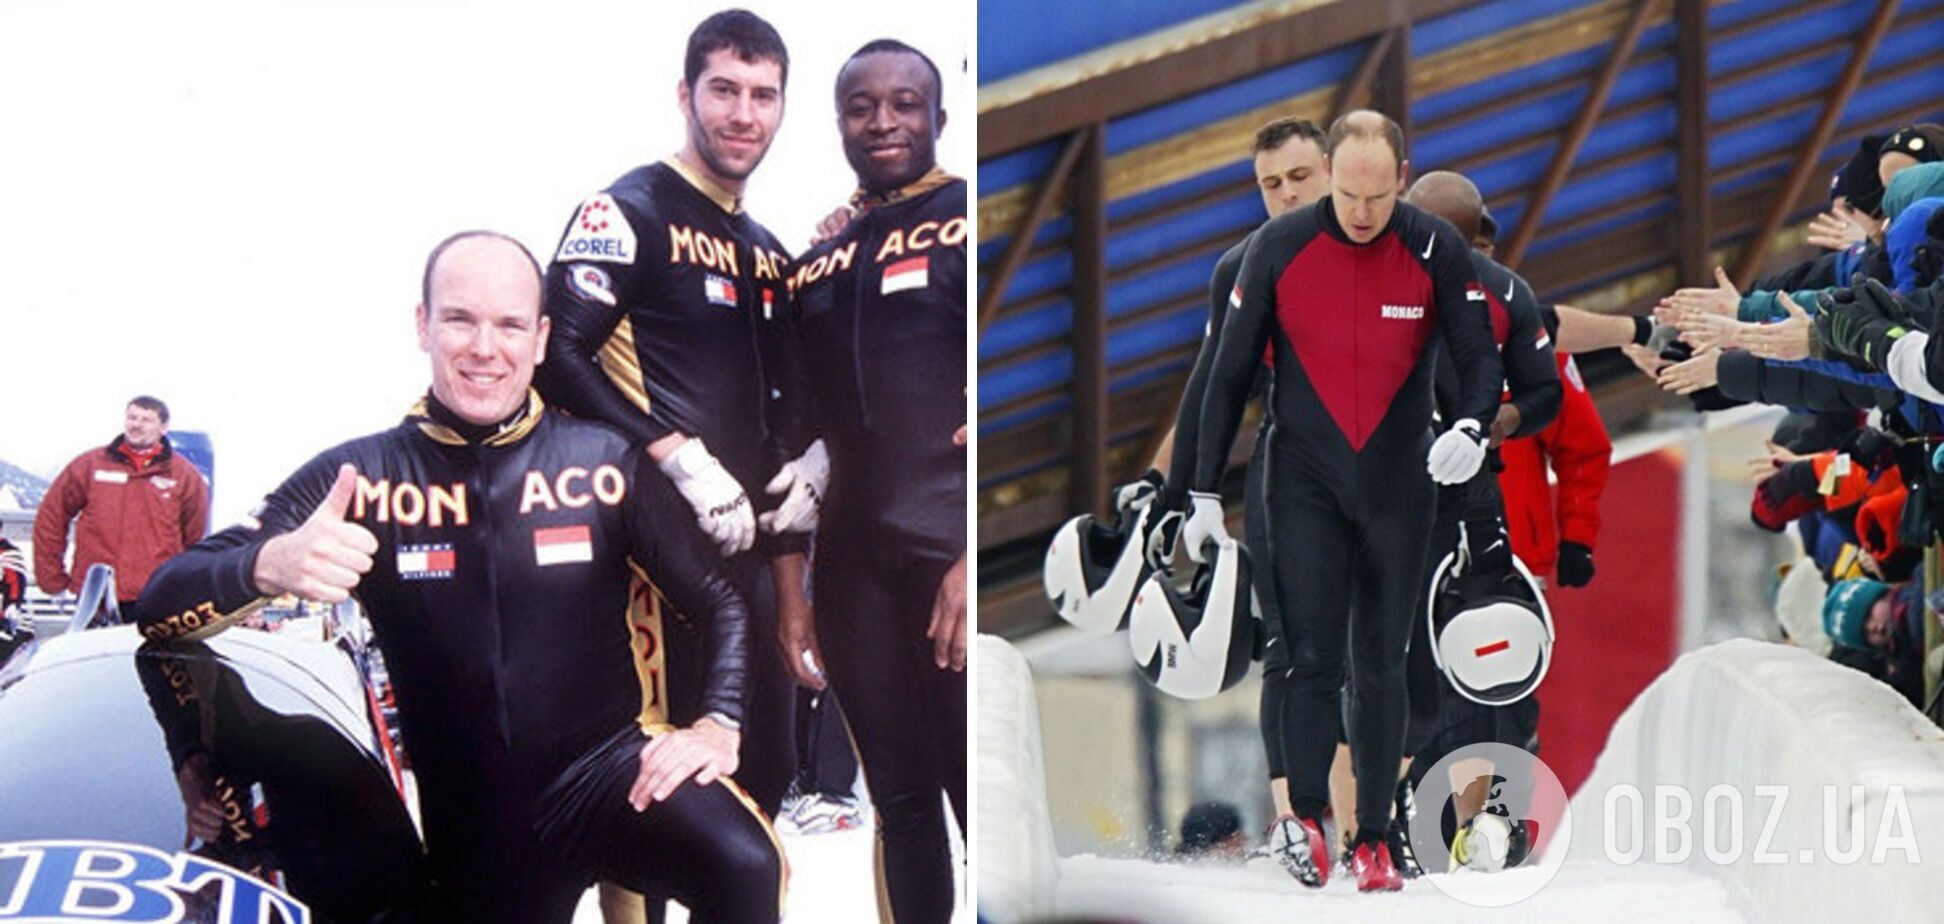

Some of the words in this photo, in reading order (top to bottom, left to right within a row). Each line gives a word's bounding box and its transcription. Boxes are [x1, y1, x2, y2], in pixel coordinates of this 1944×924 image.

[564, 237, 627, 257] COREL
[669, 223, 739, 277] MON
[875, 216, 967, 263] ACO
[1381, 304, 1424, 319] MONACO
[353, 474, 469, 528] MON
[519, 464, 626, 514] ACO
